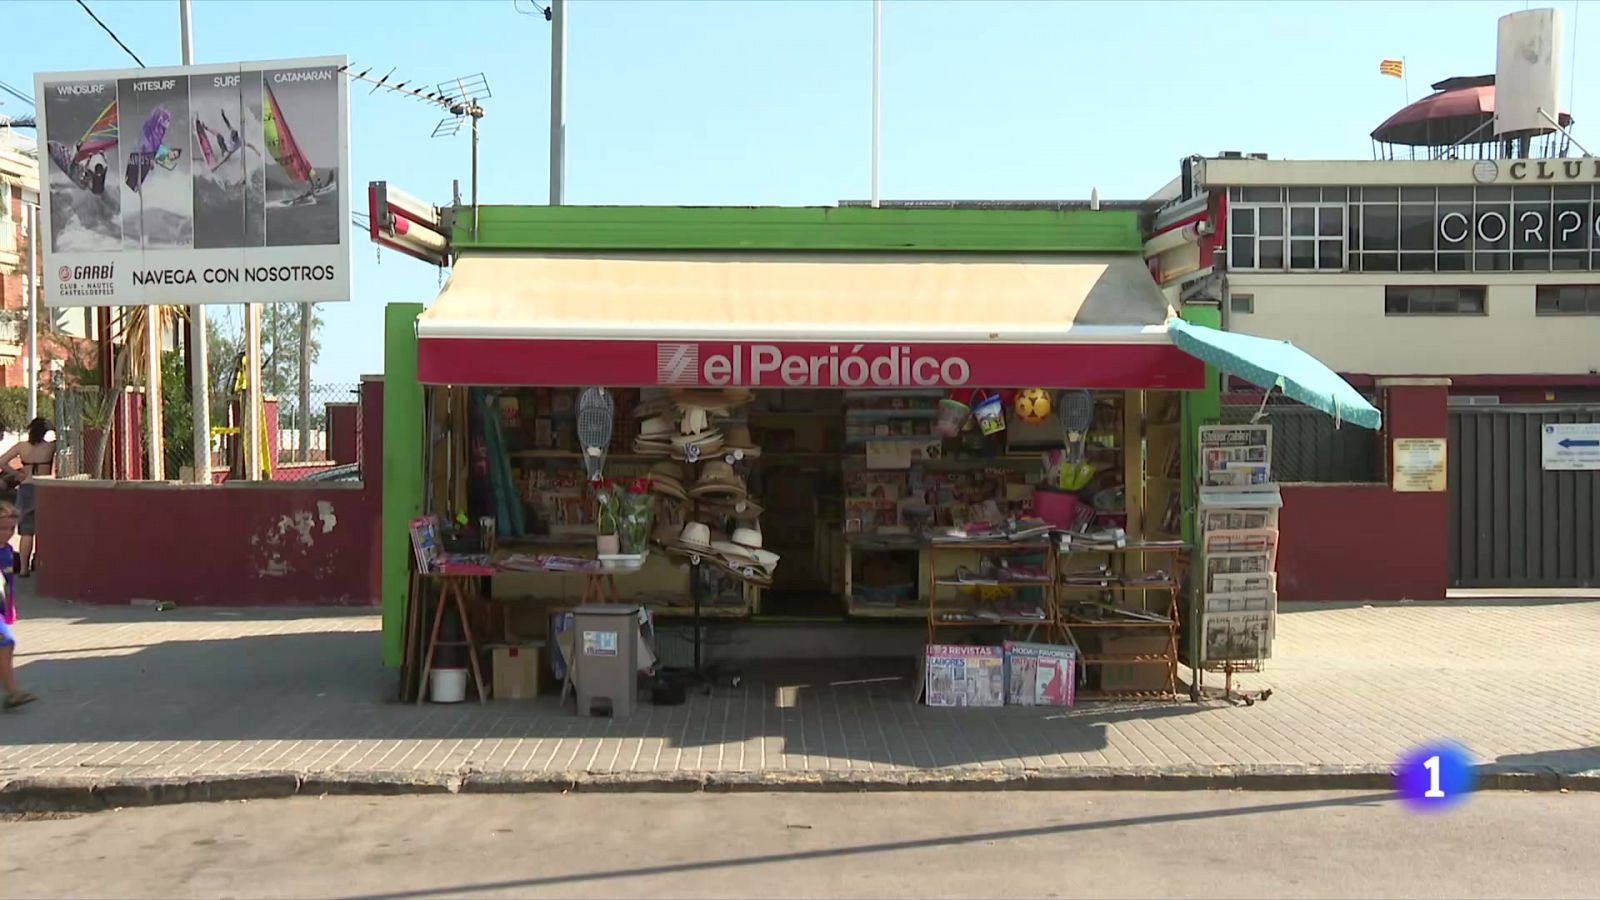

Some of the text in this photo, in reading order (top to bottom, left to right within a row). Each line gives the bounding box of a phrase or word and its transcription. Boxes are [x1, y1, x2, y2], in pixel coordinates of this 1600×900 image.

[213, 75, 241, 87] SURF
[274, 71, 331, 83] CATAMARAN
[57, 85, 105, 95] WINDSURF
[133, 80, 176, 92] KITESURF
[1440, 211, 1600, 242] CORP
[132, 265, 335, 285] NAVEGA CON NOSOTROS
[703, 344, 971, 387] el Periódico
[949, 647, 992, 655] REVISTAS
[931, 658, 965, 667] LABORES
